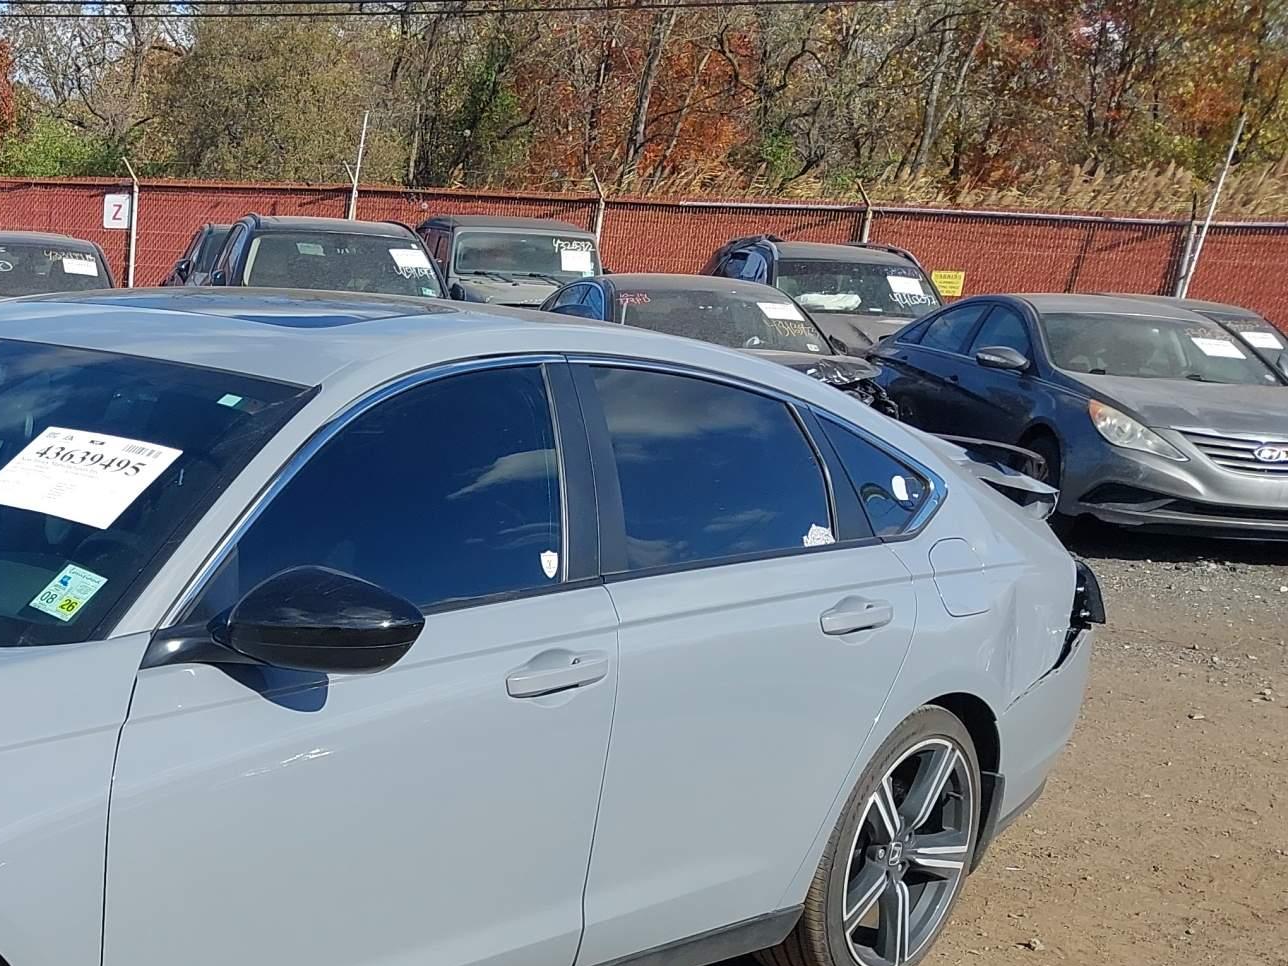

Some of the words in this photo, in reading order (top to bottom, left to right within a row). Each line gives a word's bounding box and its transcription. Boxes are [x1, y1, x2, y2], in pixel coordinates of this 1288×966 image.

[112, 203, 123, 221] Z
[35, 445, 147, 476] 43639495
[40, 590, 58, 604] 08
[60, 598, 78, 612] 26
